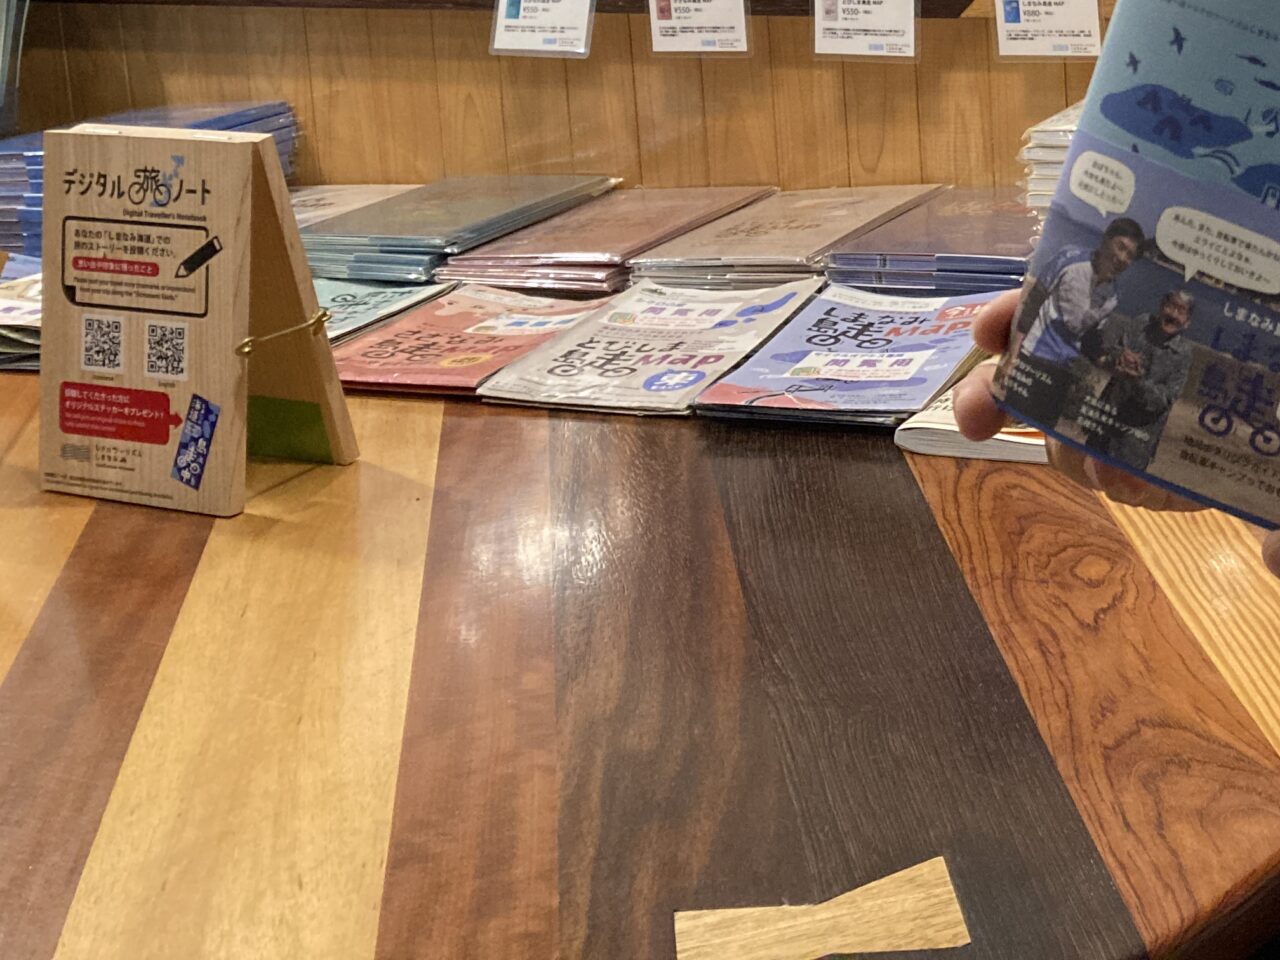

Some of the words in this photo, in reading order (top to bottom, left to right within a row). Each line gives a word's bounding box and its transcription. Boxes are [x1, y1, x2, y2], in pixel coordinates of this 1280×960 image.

[123, 208, 143, 218] Digital
[74, 229, 171, 245] あなたの「しまなみ海道」での
[824, 307, 932, 326] しまなみ
[576, 337, 686, 353] とびしま
